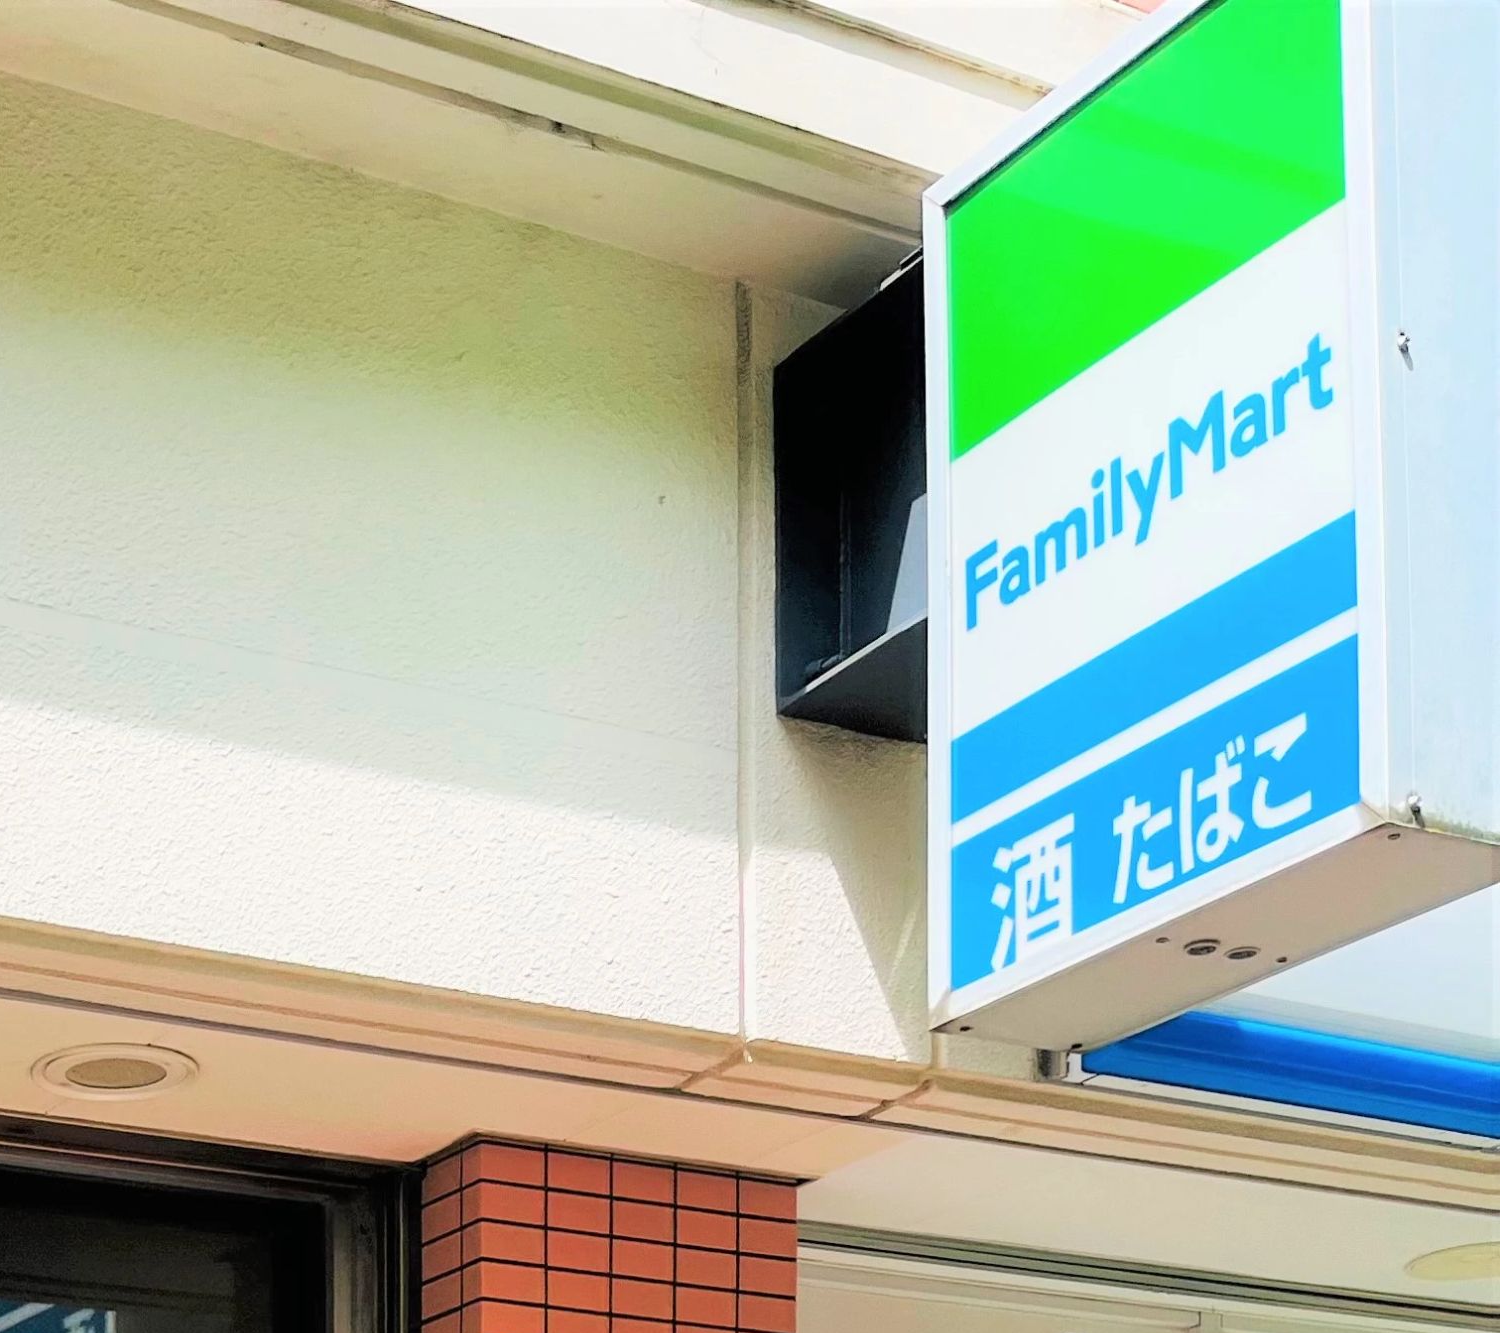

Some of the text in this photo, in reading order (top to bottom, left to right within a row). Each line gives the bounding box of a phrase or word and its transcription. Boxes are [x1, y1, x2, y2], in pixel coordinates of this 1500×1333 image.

[963, 333, 1333, 631] FamilyMart
[989, 711, 1312, 971] 酒 たばこ
